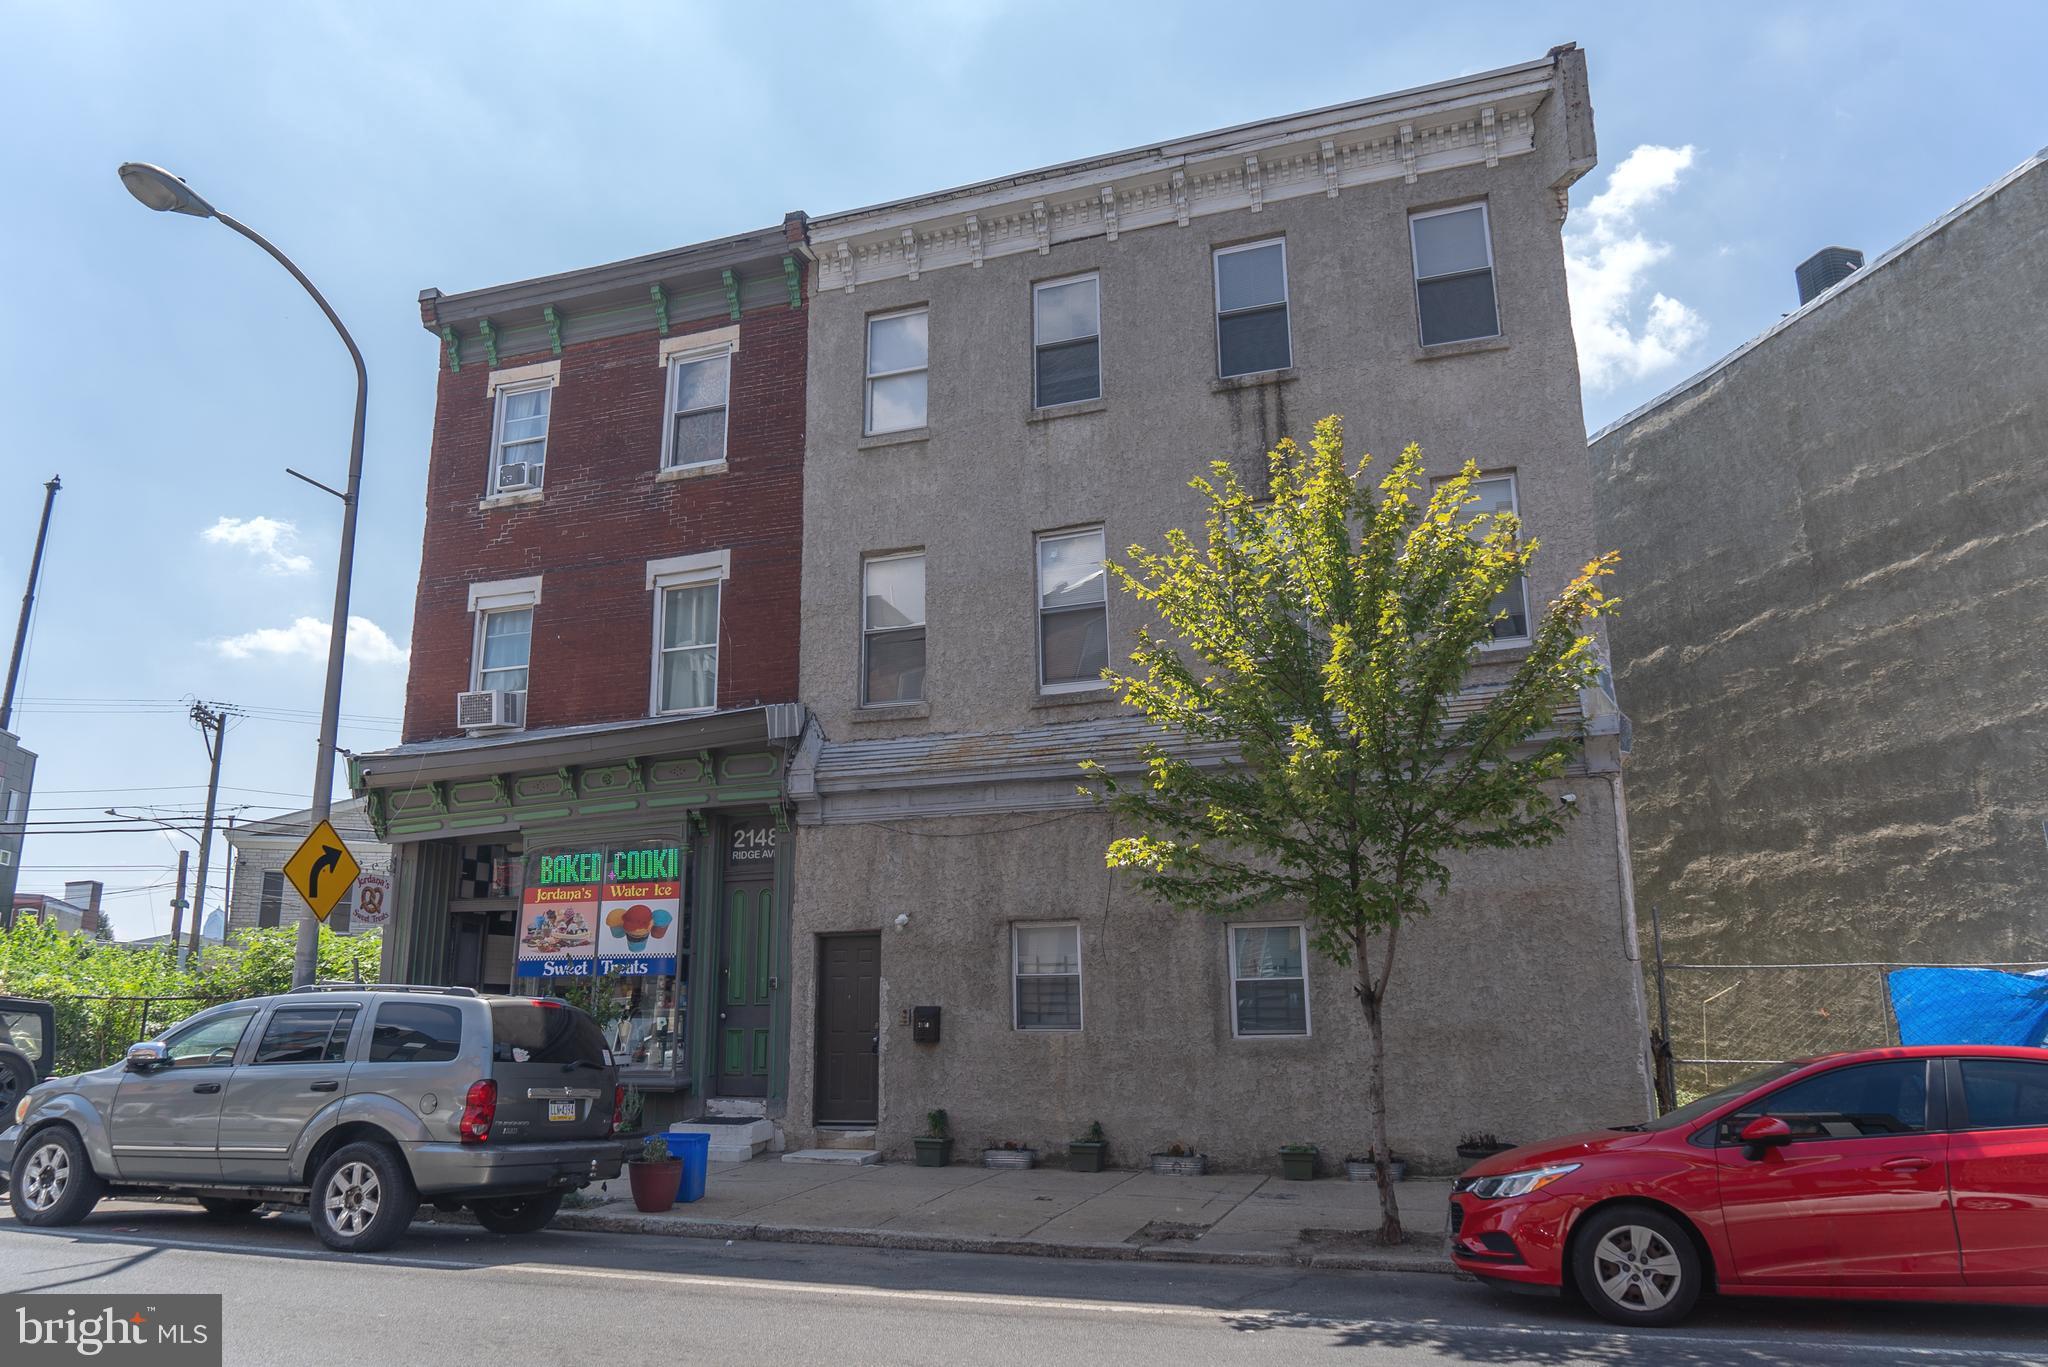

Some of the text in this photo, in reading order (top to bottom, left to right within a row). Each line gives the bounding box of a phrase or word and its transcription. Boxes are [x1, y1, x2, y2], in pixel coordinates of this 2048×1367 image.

[734, 828, 776, 848] 2148
[732, 849, 776, 860] RIDGE AV
[540, 852, 602, 884] BAKED
[535, 888, 592, 903] Jordana's
[610, 884, 672, 898] Water Ice
